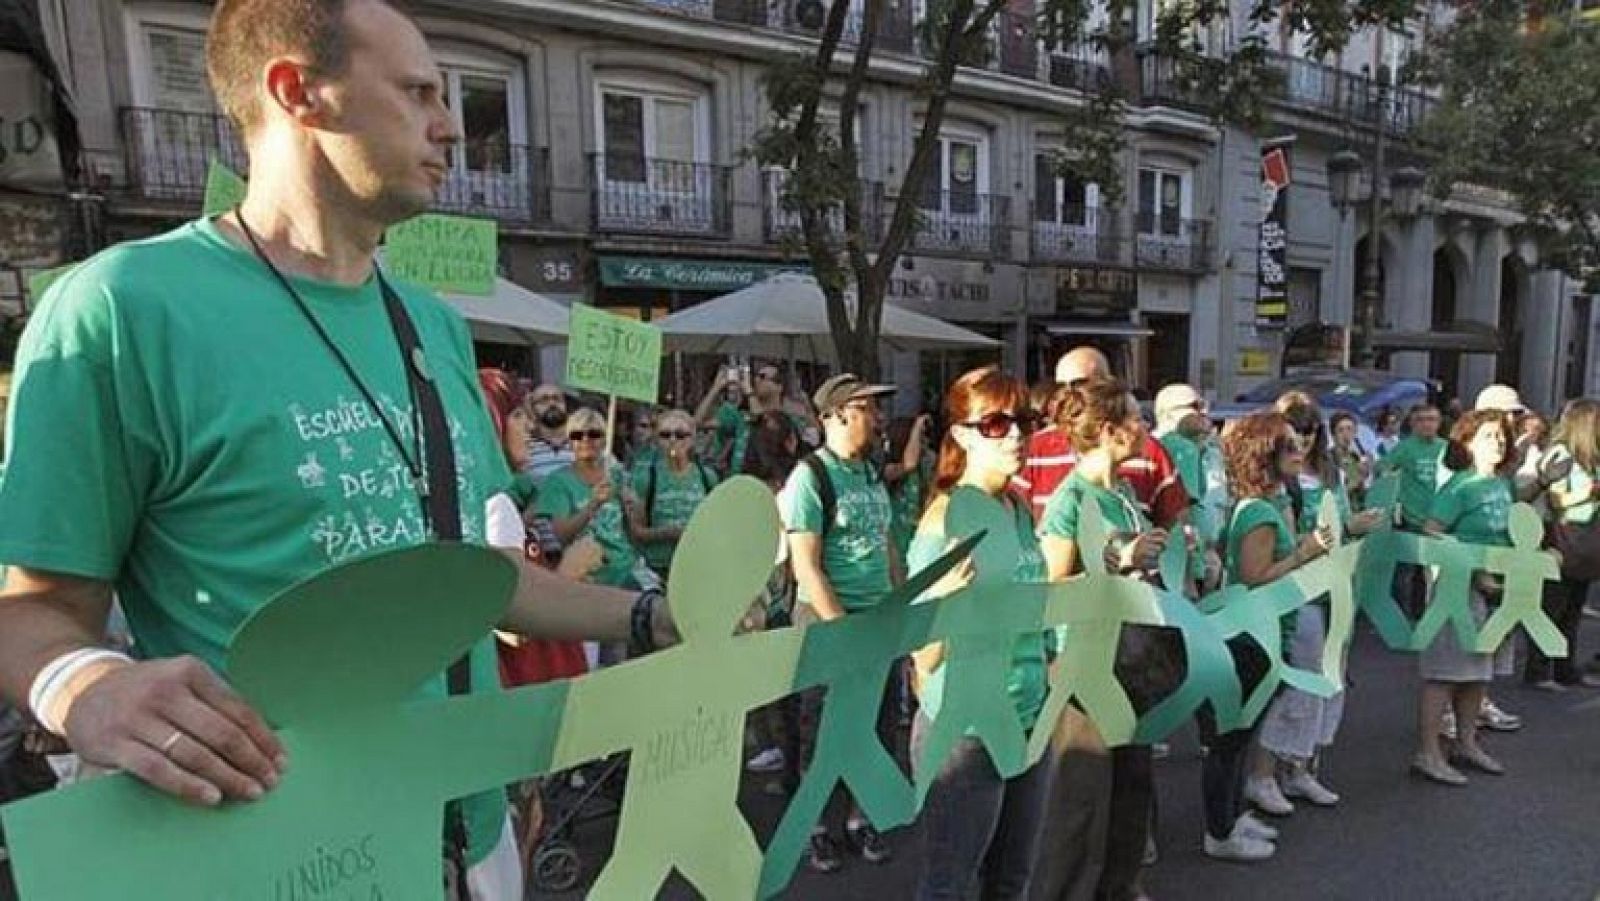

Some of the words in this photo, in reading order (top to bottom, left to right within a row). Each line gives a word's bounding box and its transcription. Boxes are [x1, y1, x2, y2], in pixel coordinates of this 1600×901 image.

[542, 261, 572, 281] 35
[584, 322, 650, 358] ESTOY
[339, 469, 377, 498] DE
[319, 515, 408, 556] PARA
